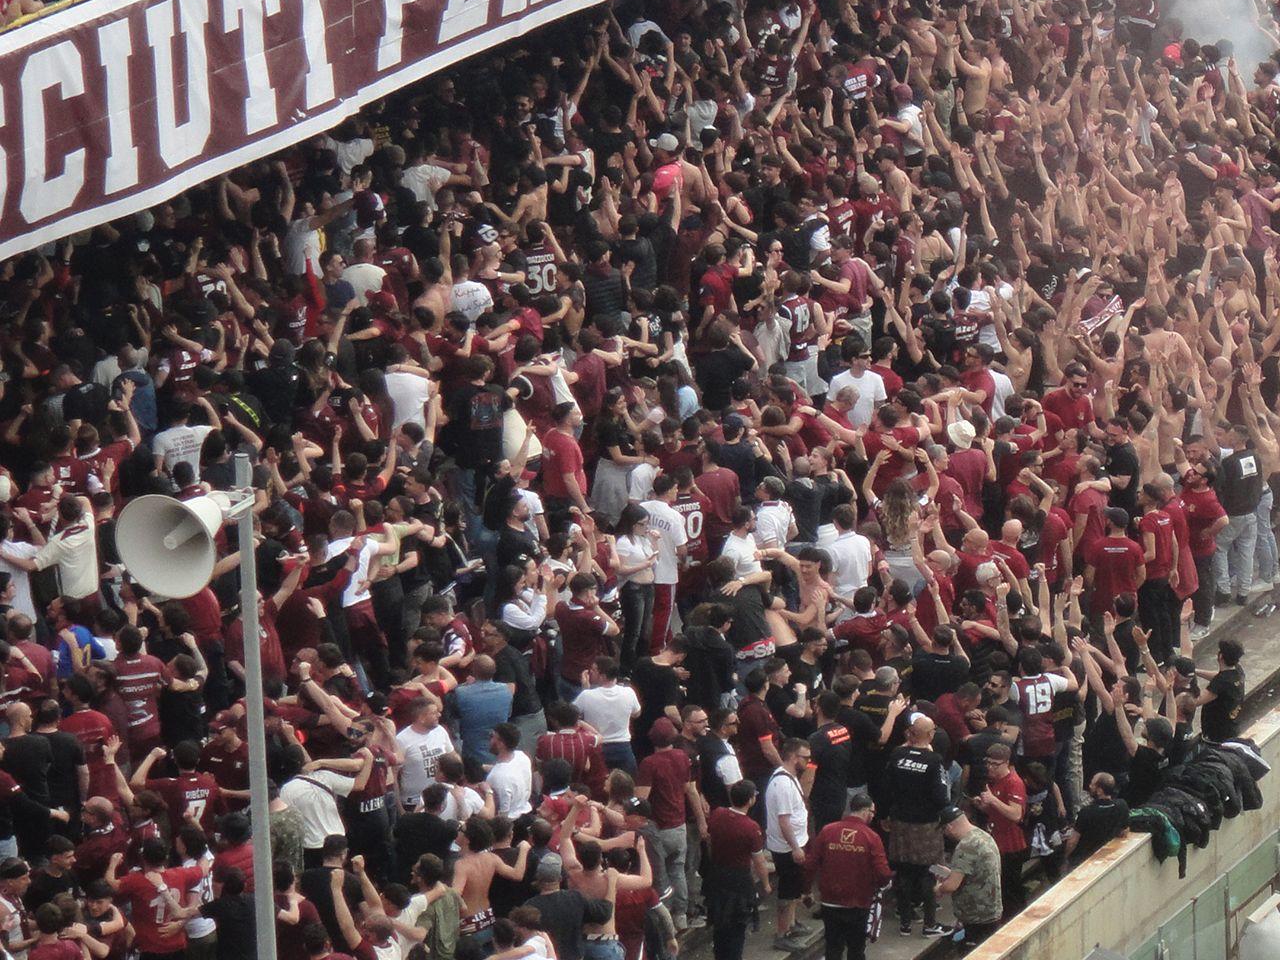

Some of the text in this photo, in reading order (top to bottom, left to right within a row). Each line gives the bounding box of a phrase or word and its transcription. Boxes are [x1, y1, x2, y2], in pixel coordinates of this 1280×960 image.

[528, 263, 557, 295] 30
[1025, 682, 1052, 715] 19
[829, 843, 865, 853] GIVOVA
